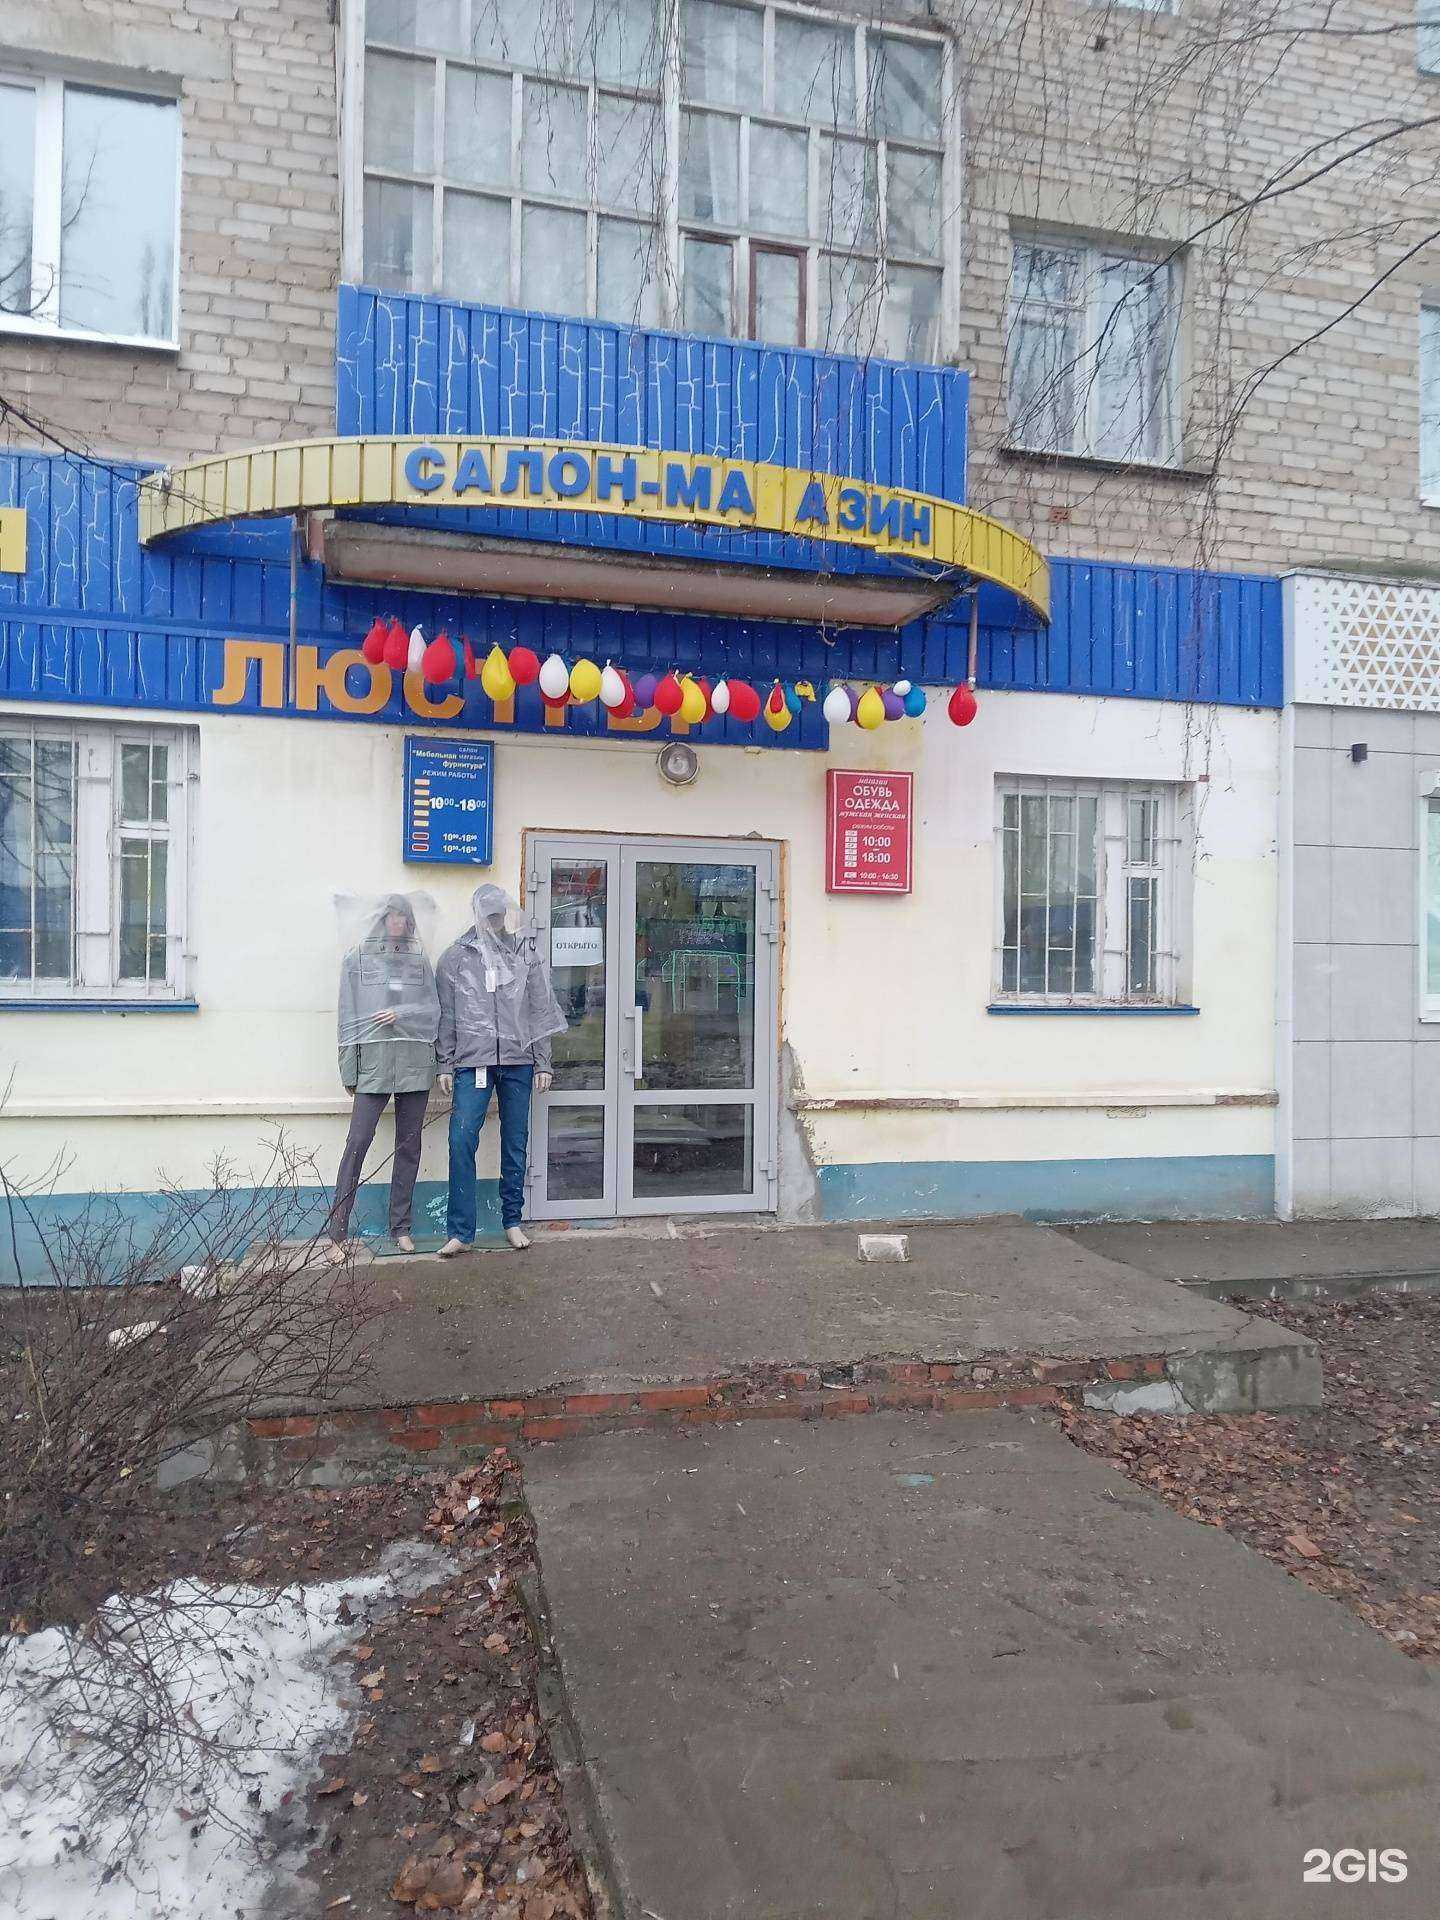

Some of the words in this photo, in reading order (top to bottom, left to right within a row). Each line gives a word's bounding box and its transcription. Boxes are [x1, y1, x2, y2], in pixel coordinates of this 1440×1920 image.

[795, 480, 930, 546] АЗИН
[212, 639, 691, 735] ЛЮС
[422, 769, 447, 777] РЕЖИМ
[852, 785, 893, 798] ОБУВЬ
[844, 797, 900, 811] ОДЕЖДА
[861, 835, 892, 848] 10:00
[861, 851, 892, 864] 18:00
[556, 942, 598, 950] ОТКРЫТО
